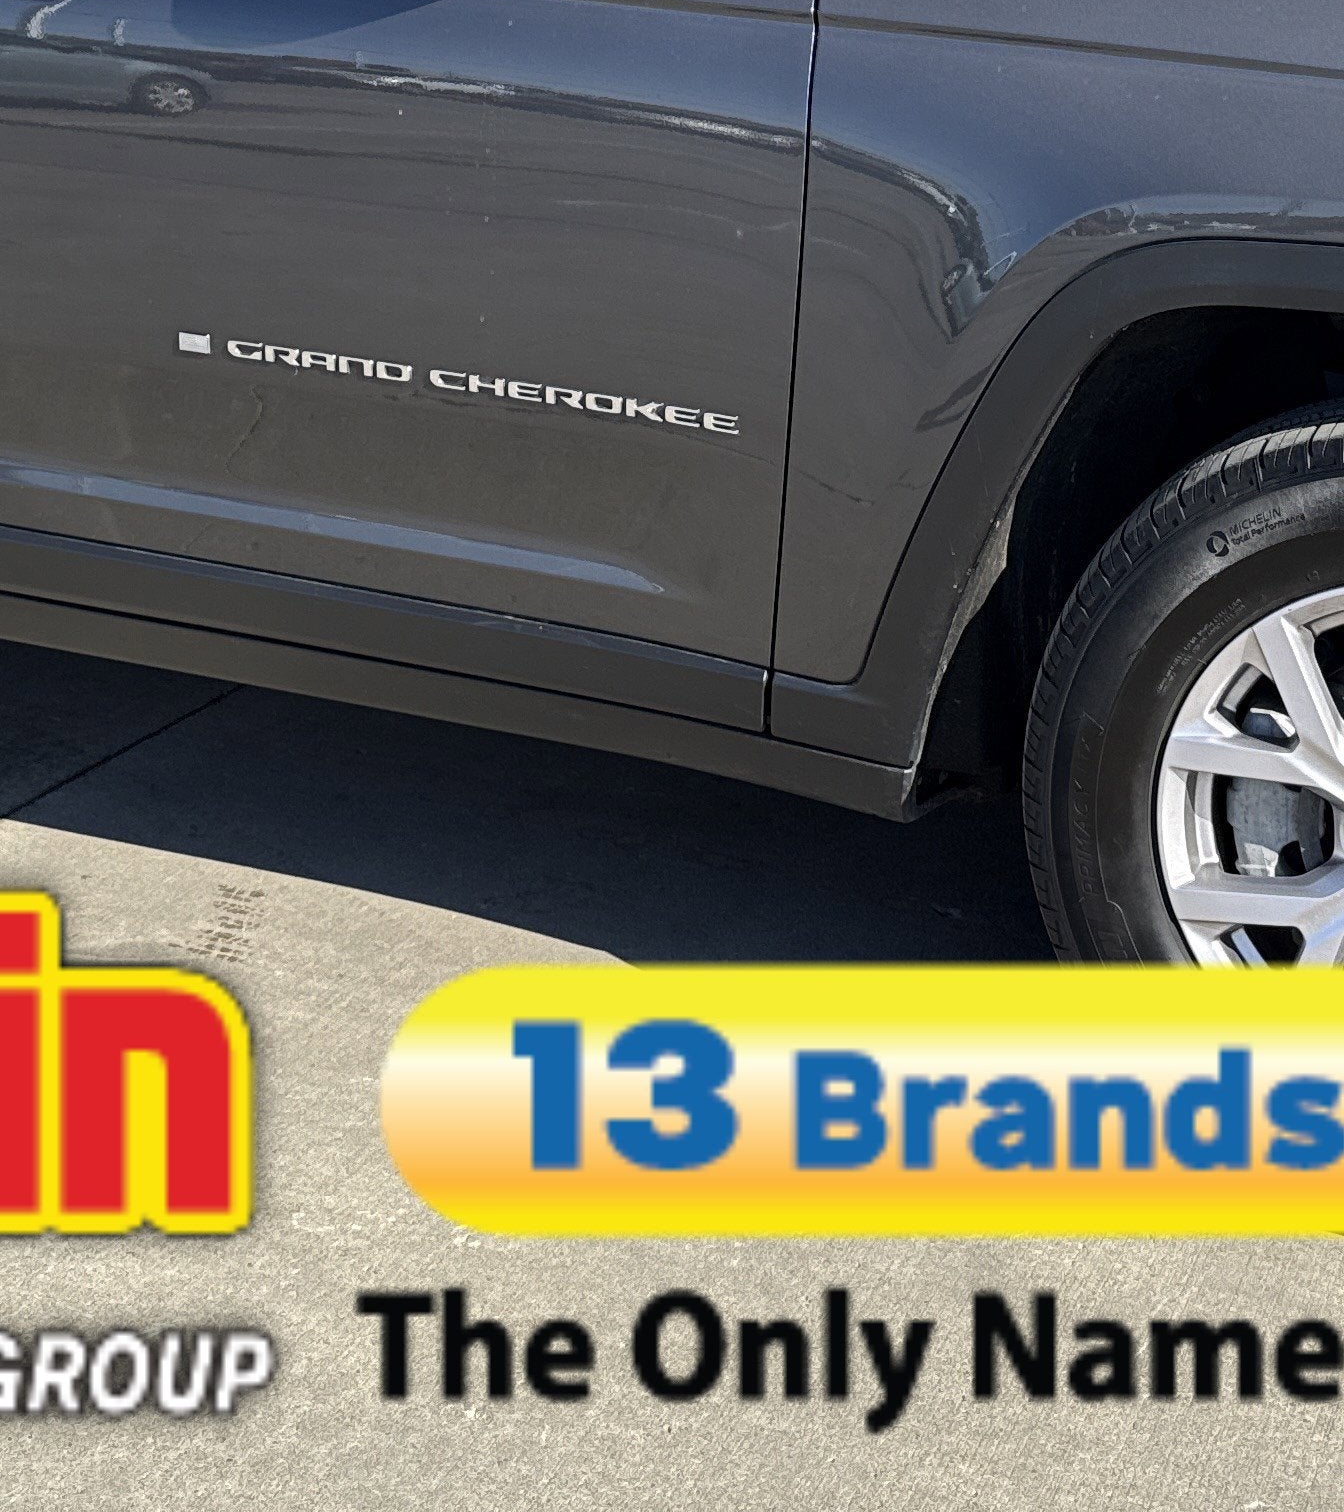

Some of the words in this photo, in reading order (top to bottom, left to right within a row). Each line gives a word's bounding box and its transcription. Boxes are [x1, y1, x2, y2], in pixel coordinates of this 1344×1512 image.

[226, 339, 413, 383] GRAND
[428, 368, 741, 435] CHEROKEE
[1230, 507, 1282, 535] MICHELIN
[1231, 531, 1251, 547] Total
[1251, 512, 1307, 538] Performance
